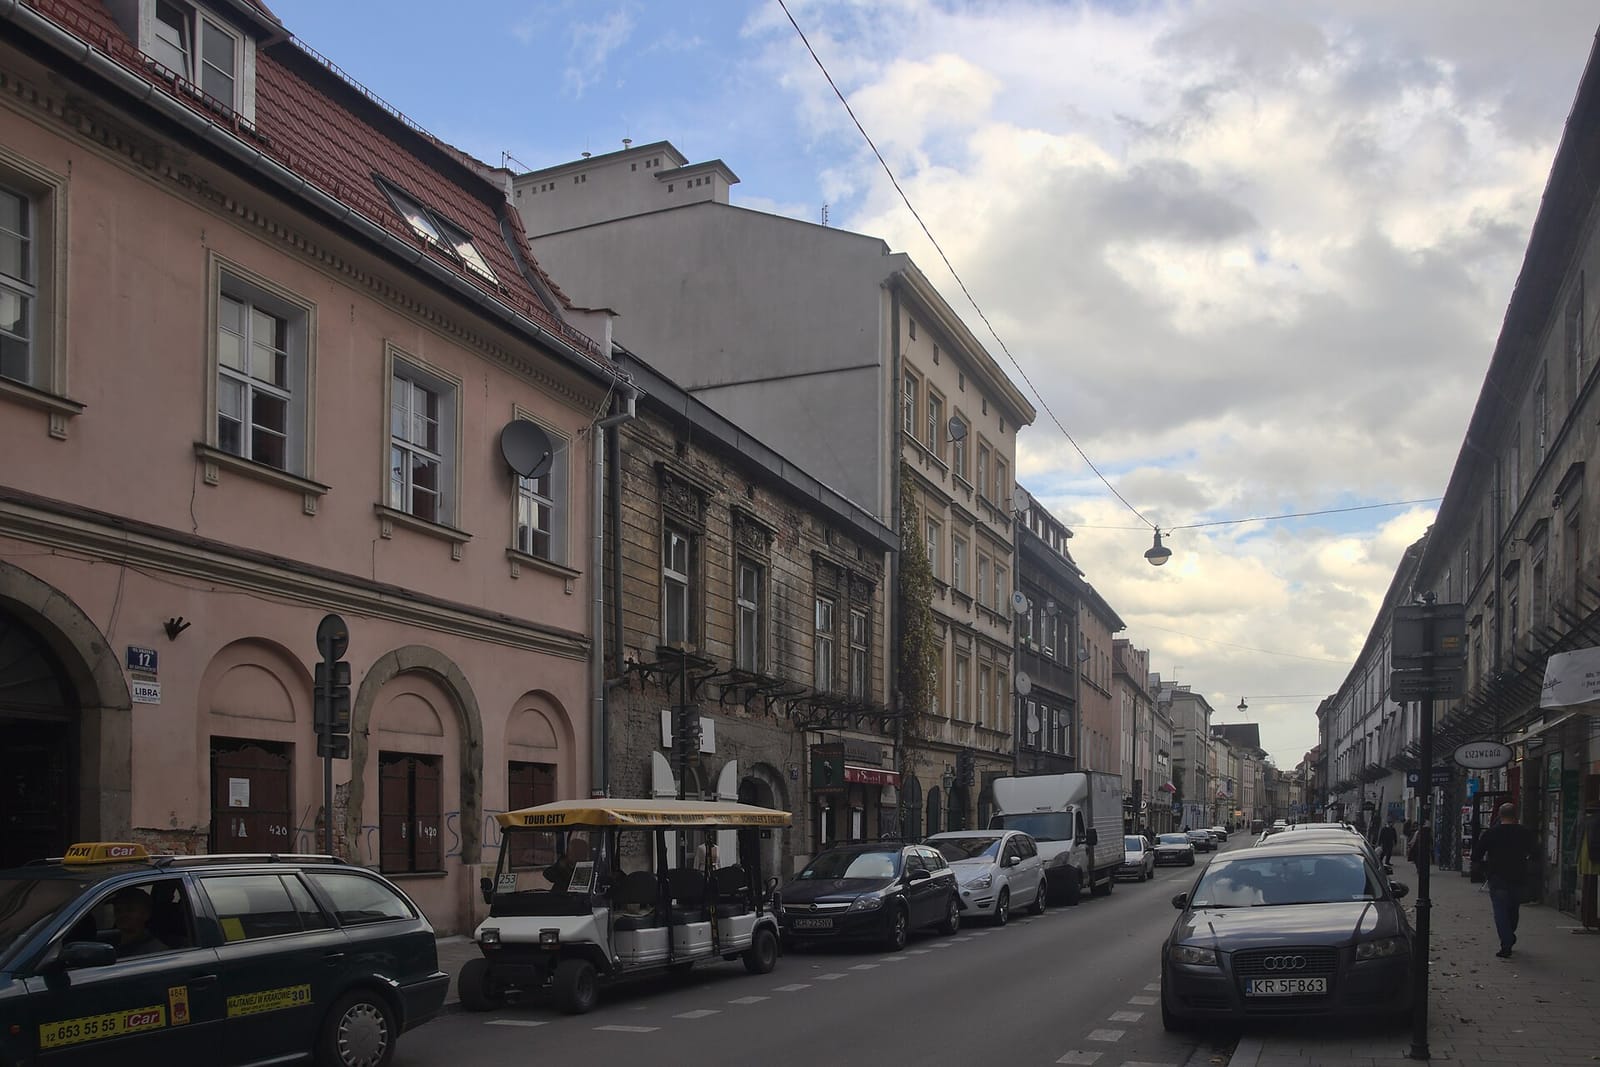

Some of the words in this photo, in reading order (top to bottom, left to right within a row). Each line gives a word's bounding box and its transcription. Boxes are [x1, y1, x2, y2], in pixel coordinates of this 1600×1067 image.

[135, 687, 158, 697] LIBRA
[523, 814, 546, 825] TOUR
[546, 813, 566, 824] CITY
[269, 824, 288, 836] 420
[68, 847, 91, 857] TAXI
[499, 874, 516, 884] 253
[1254, 980, 1275, 993] KR
[1279, 979, 1324, 992] 5F863
[46, 1033, 56, 1042] 12
[58, 1024, 80, 1040] 653
[83, 1021, 98, 1036] 55
[101, 1018, 116, 1033] 55
